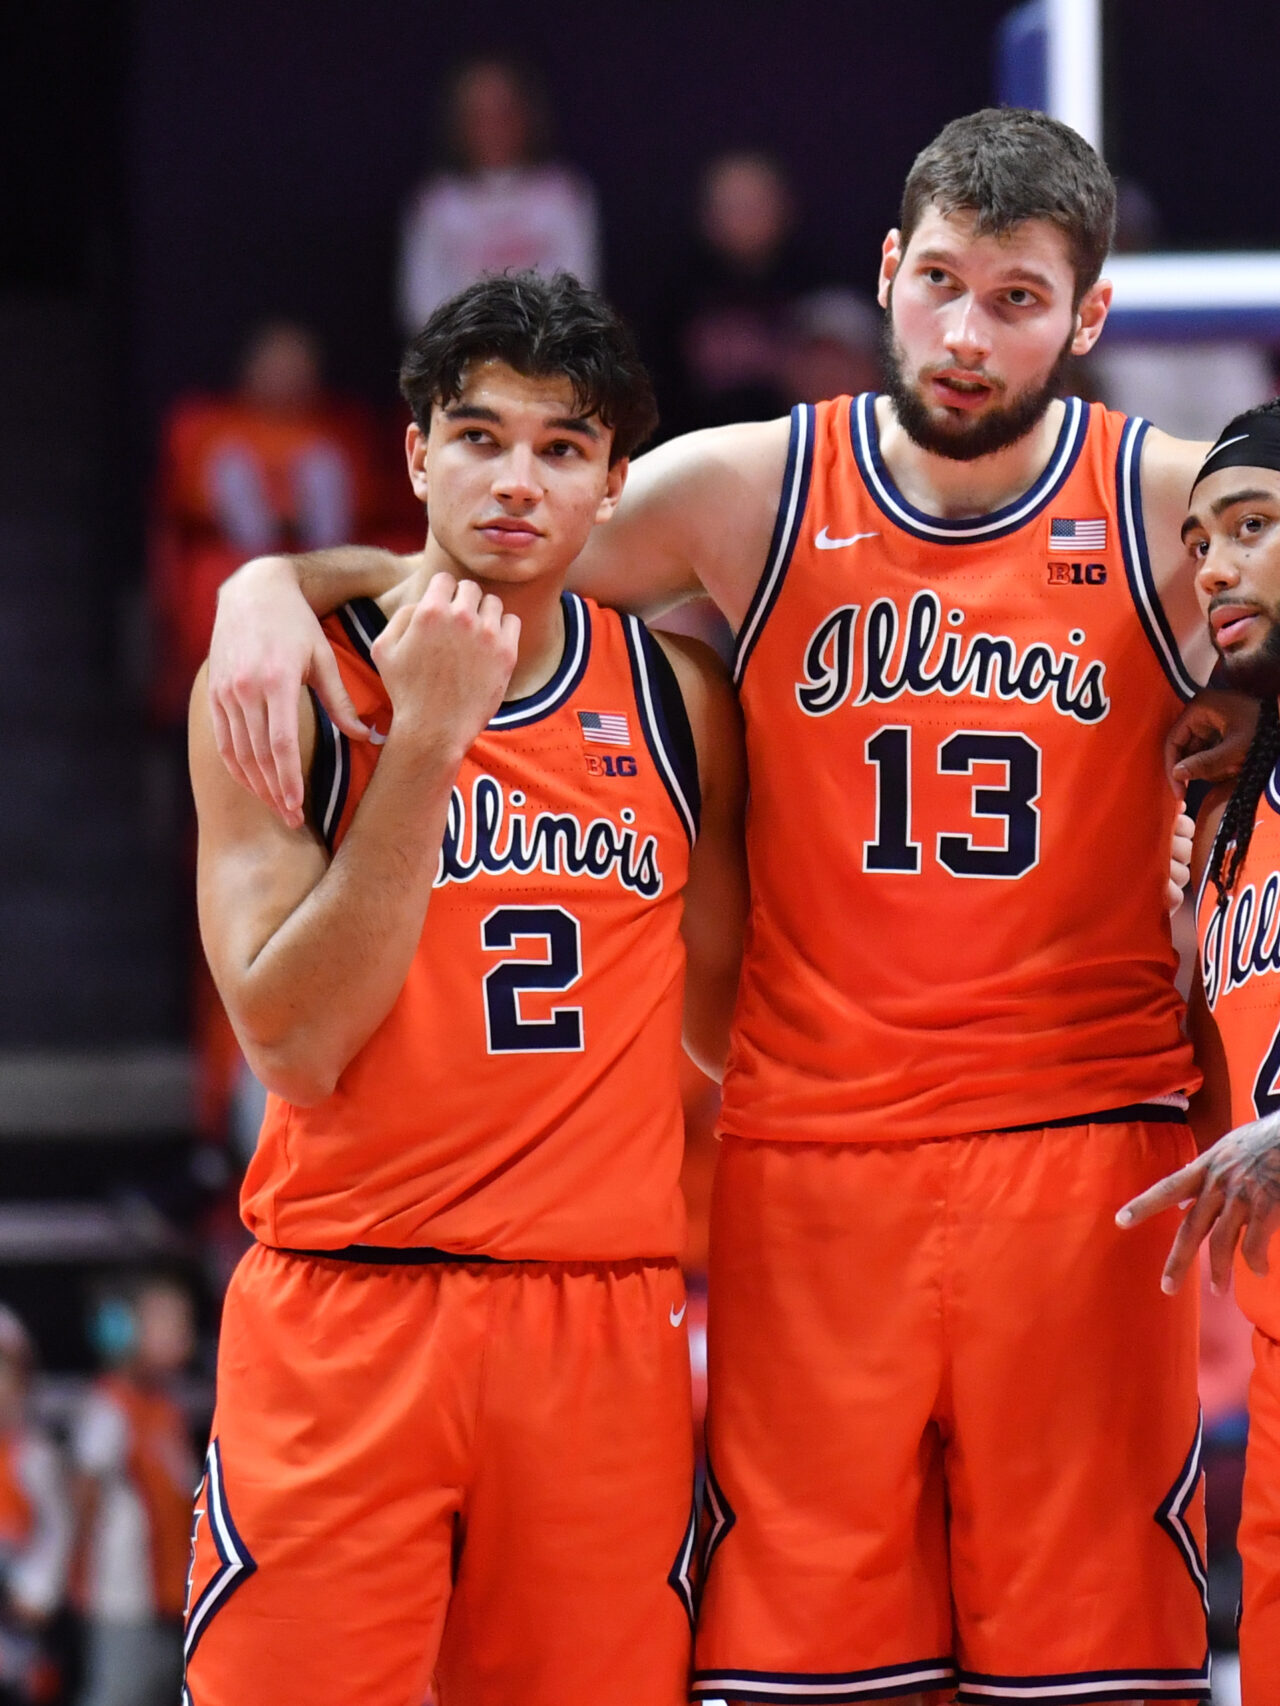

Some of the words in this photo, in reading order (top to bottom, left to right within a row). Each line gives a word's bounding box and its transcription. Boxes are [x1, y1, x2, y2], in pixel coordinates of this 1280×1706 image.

[795, 589, 1110, 725] Illinois
[432, 774, 663, 900] llinois
[862, 724, 1042, 880] 13
[479, 904, 585, 1054] 2
